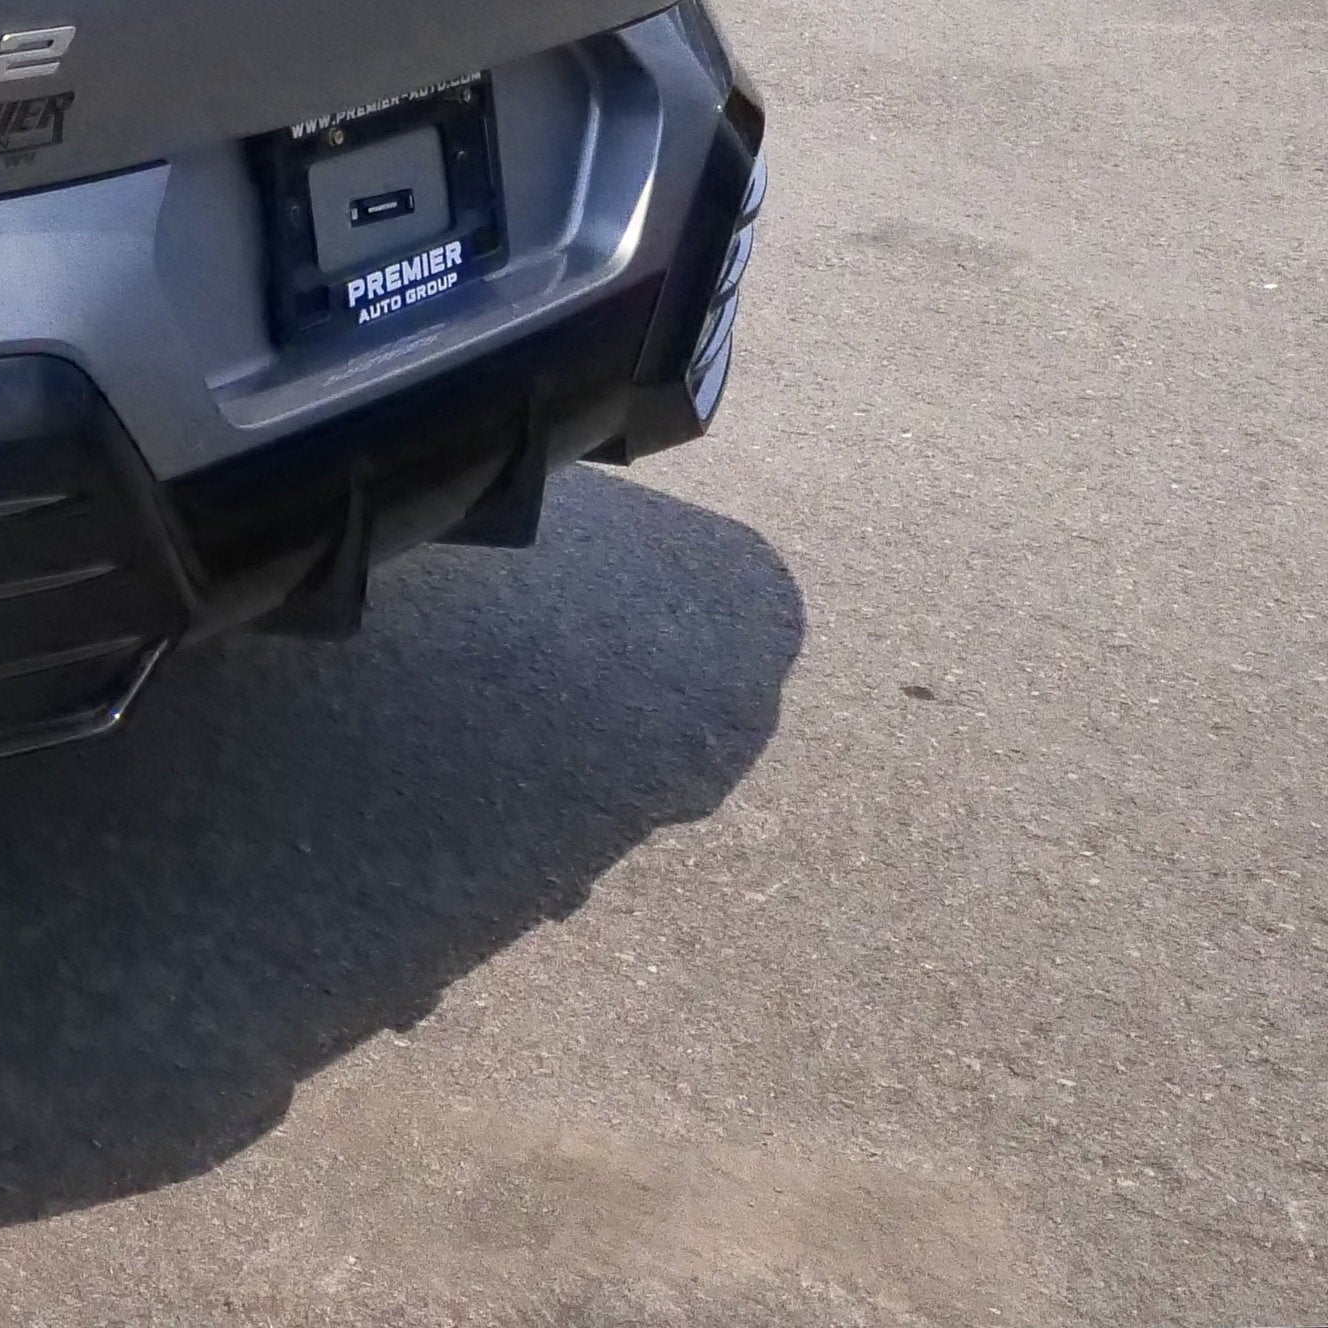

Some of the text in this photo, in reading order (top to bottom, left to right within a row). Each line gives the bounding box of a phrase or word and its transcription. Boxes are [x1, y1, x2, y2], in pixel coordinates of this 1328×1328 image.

[348, 240, 463, 308] PREMIER
[359, 272, 458, 324] AUTO GROUP
